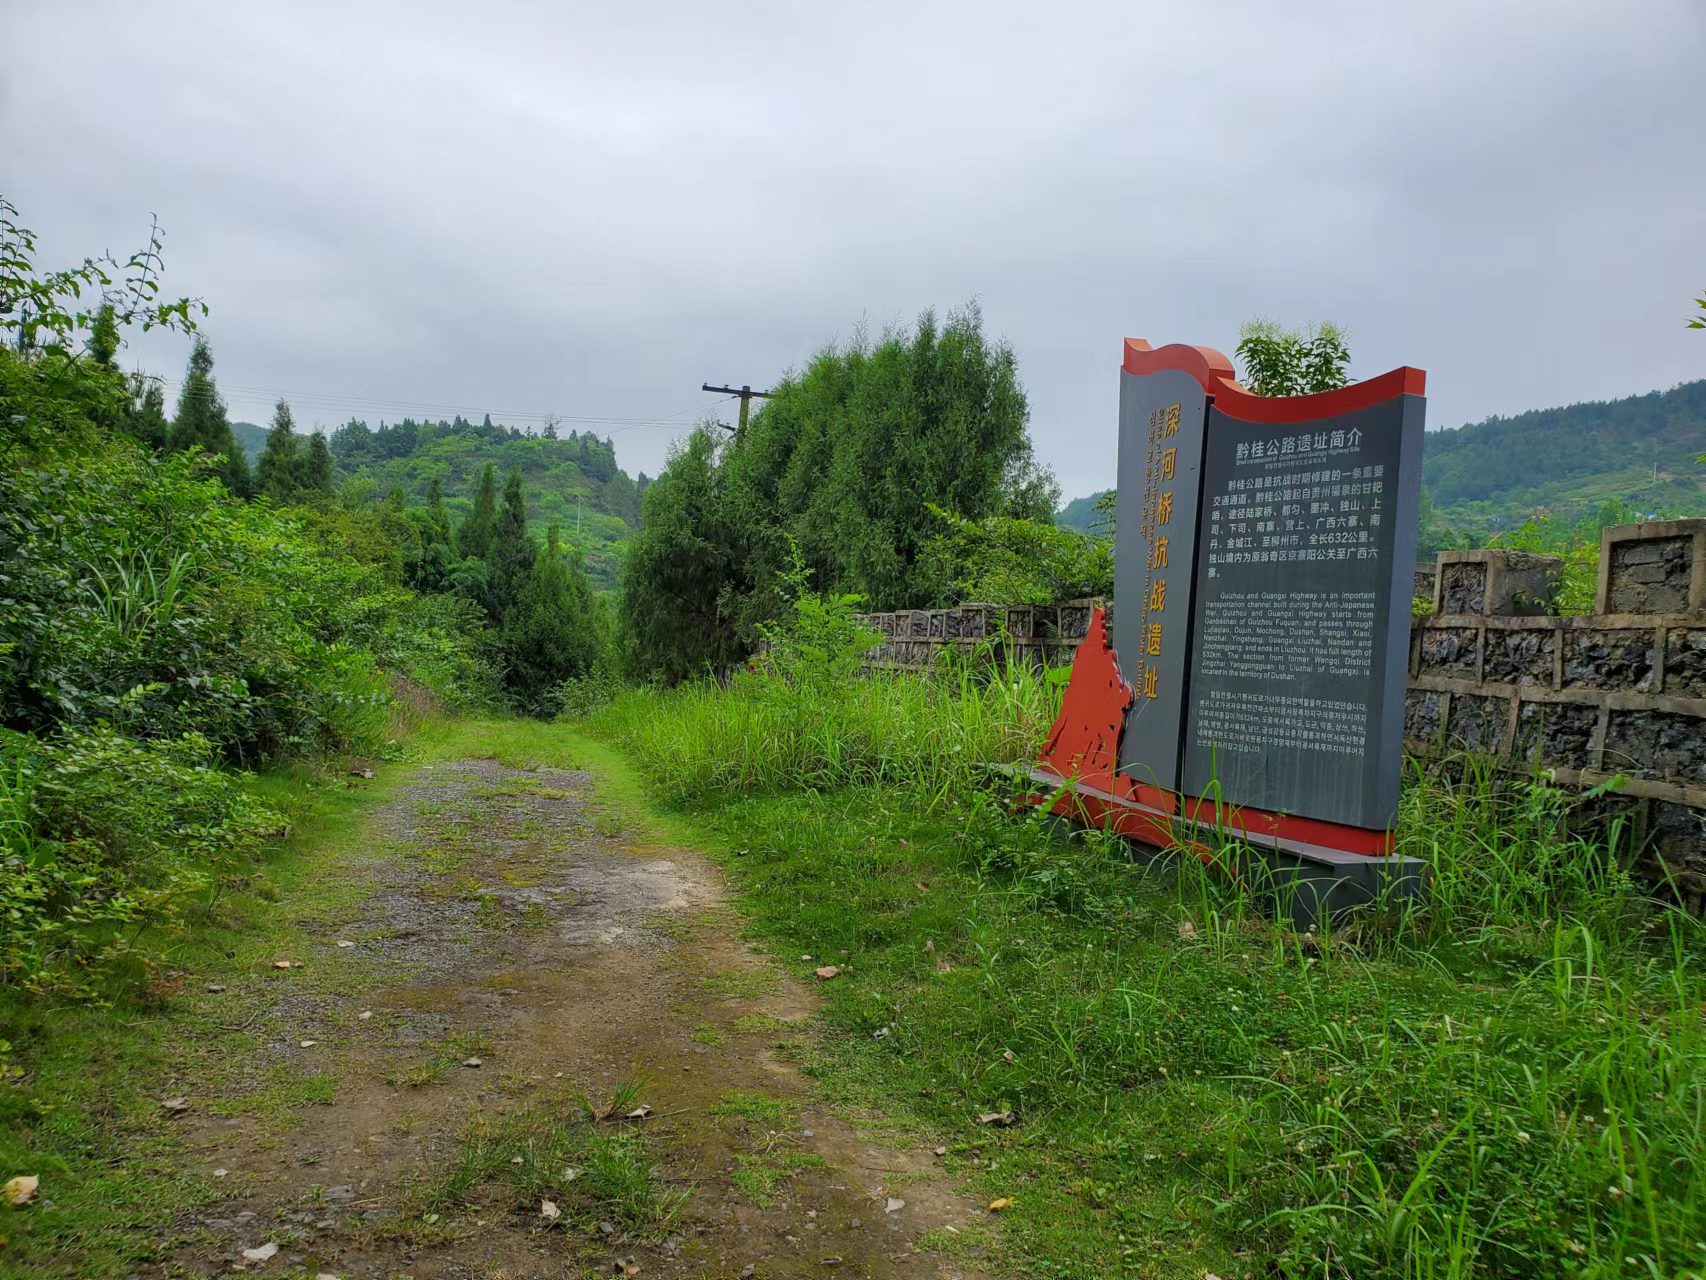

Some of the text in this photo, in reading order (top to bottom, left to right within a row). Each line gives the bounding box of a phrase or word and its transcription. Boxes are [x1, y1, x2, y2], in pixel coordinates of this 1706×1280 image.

[1236, 427, 1362, 460] 黔桂公路遗址简介
[1228, 465, 1384, 491] 黔桂公路是抗战时期修建的一条重要
[1143, 403, 1180, 698] 深河桥抗战遗址
[1261, 592, 1286, 600] Guangxi
[1342, 592, 1375, 600] important
[1268, 610, 1293, 618] Guangxi
[1299, 610, 1327, 618] Highway
[1346, 620, 1373, 629] through
[1269, 636, 1294, 645] Guangxi
[1328, 638, 1354, 646] Nandan
[1341, 648, 1362, 657] length
[1315, 656, 1340, 665] Wengqi
[1345, 658, 1371, 666] District
[1240, 671, 1262, 679] territory
[1330, 667, 1358, 676] Guangxi
